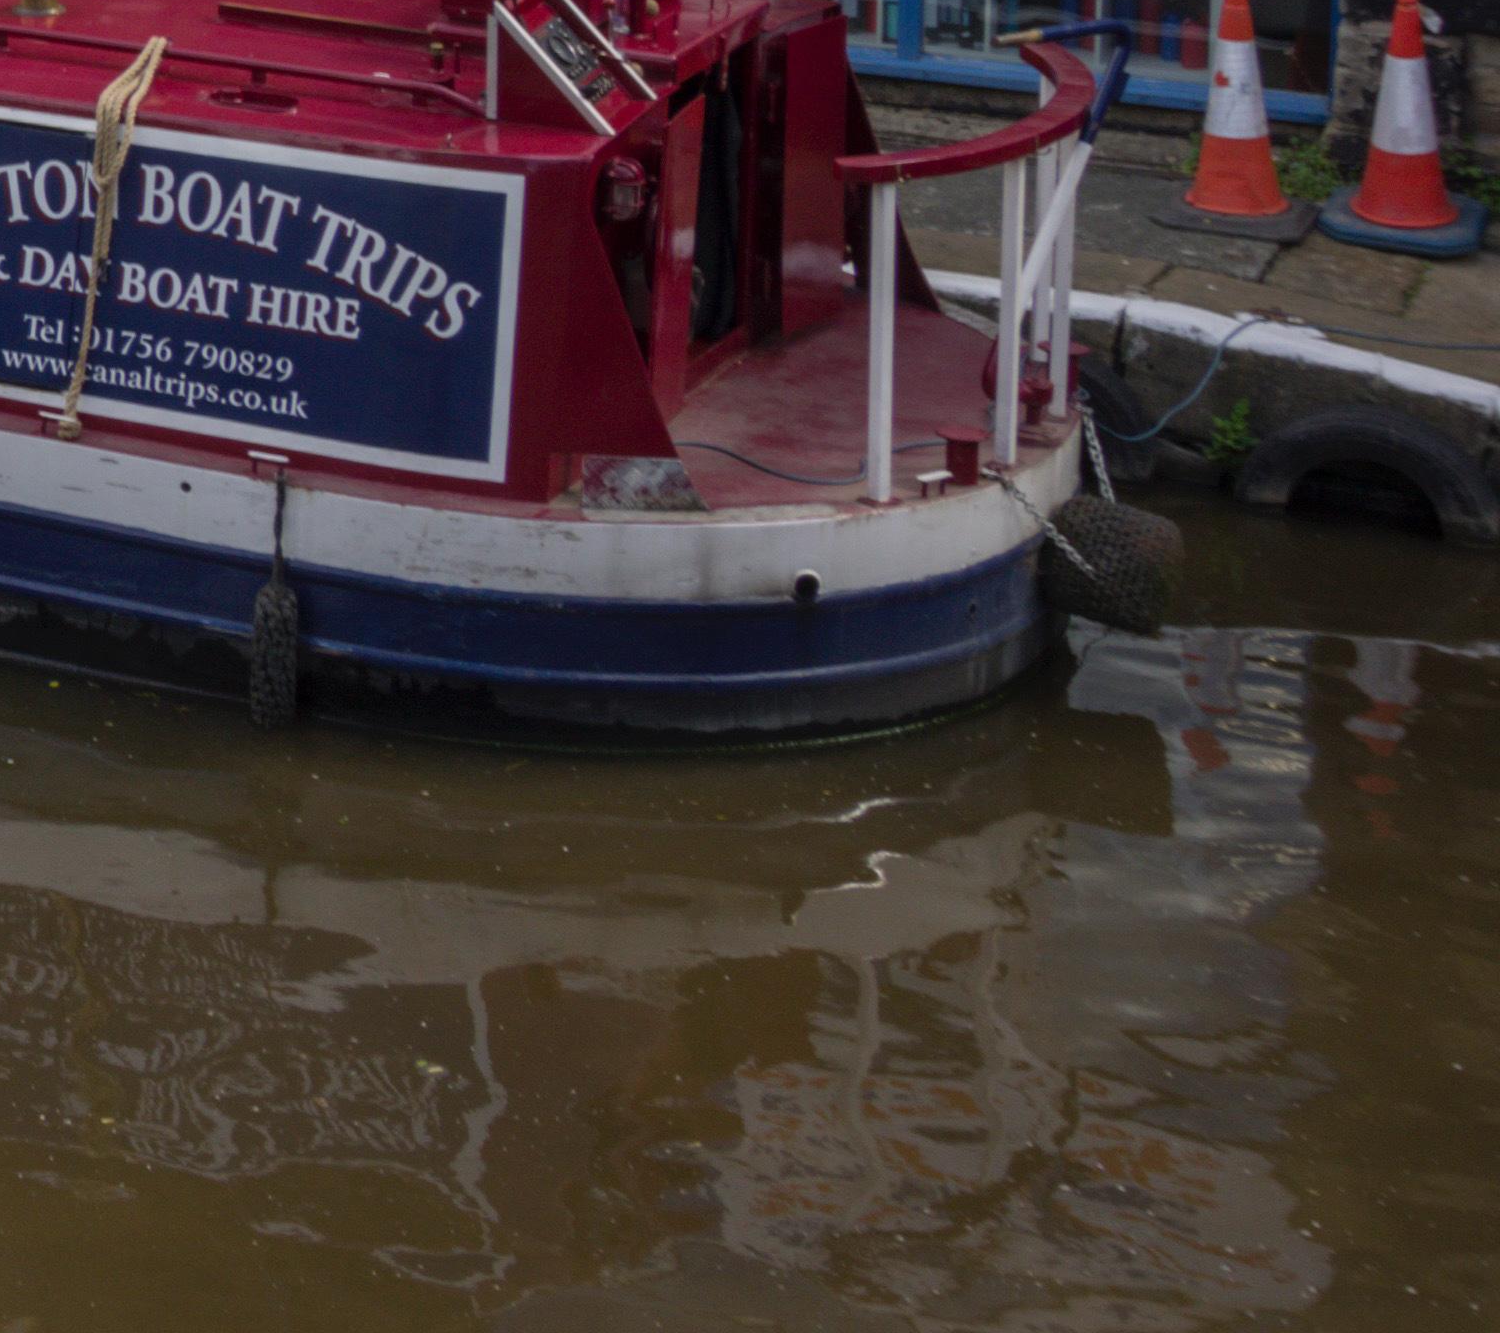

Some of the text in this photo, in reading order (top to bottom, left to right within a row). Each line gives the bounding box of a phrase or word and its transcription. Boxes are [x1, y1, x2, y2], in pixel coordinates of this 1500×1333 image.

[138, 163, 300, 253] BOAT
[306, 204, 482, 339] TRIPS
[117, 261, 238, 319] BOAT
[246, 282, 361, 340] HIRE
[184, 341, 294, 383] 790829
